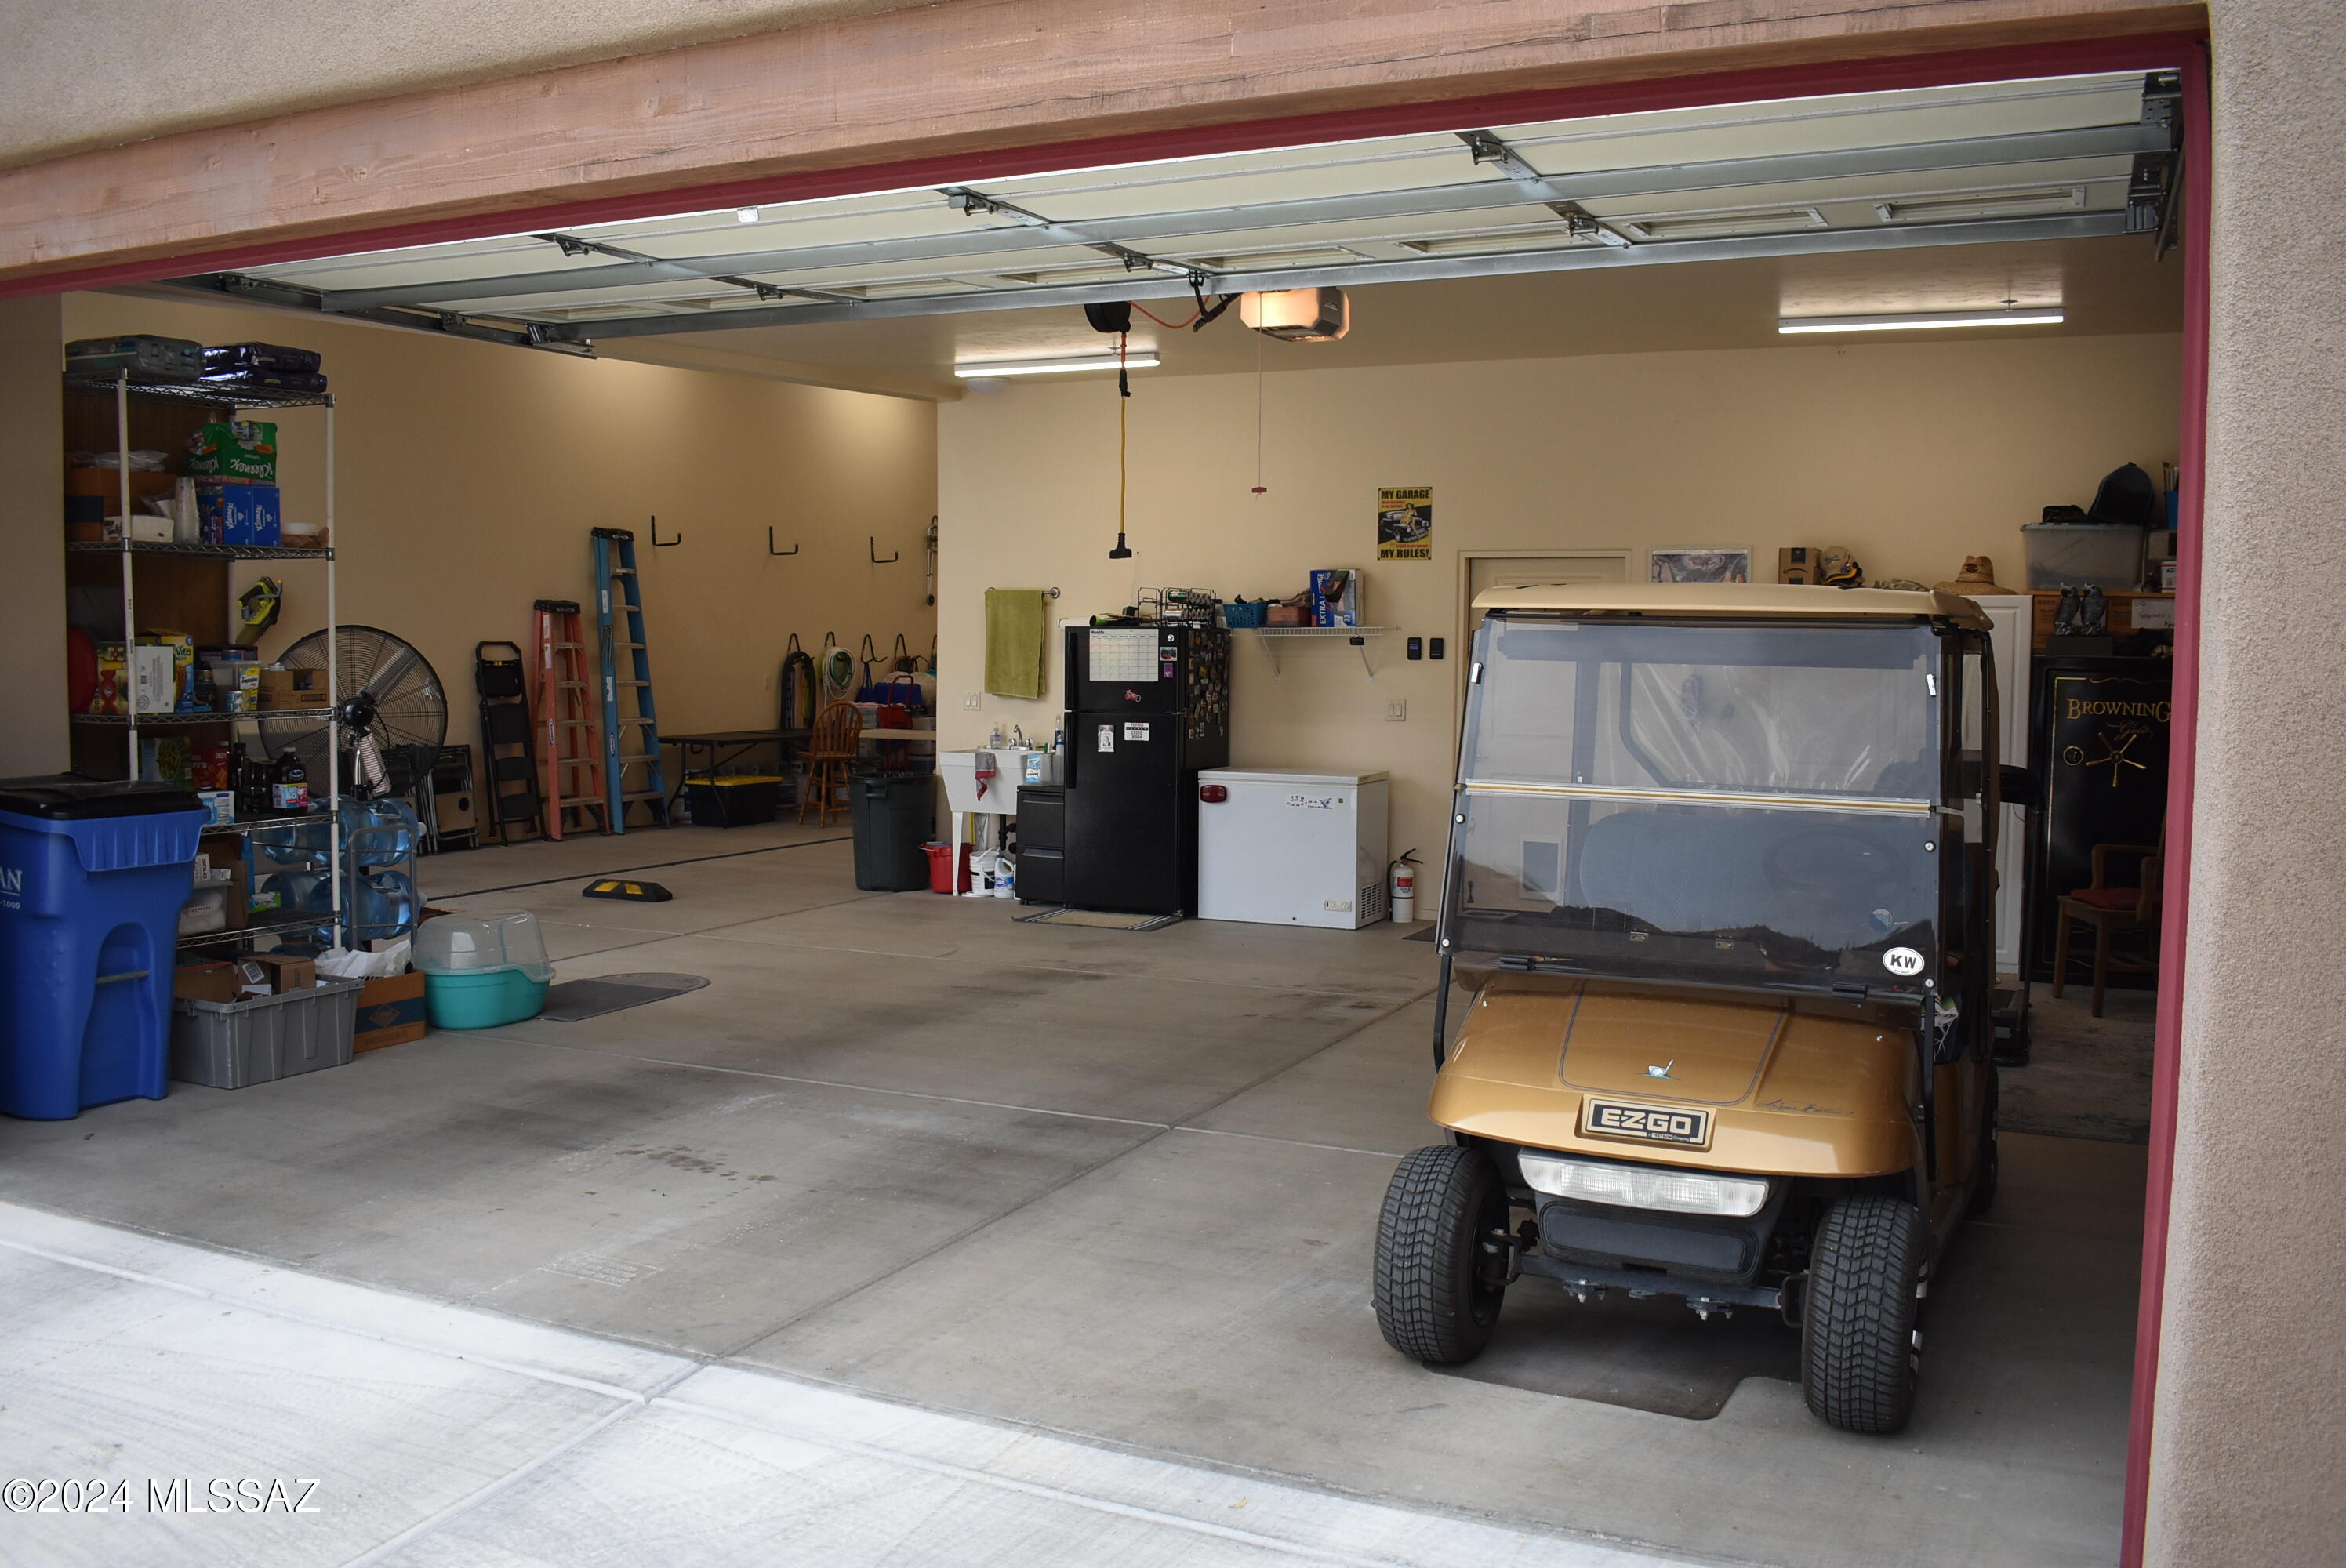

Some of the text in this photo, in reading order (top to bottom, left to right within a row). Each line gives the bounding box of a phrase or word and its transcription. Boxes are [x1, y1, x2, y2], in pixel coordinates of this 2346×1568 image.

[230, 459, 273, 479] Kleenex
[1381, 489, 1430, 499] MY GARAGE
[1380, 549, 1429, 558] MY RULES!
[176, 645, 192, 656] Vita
[2066, 697, 2171, 723] BROWNING
[1890, 954, 1917, 970] KW
